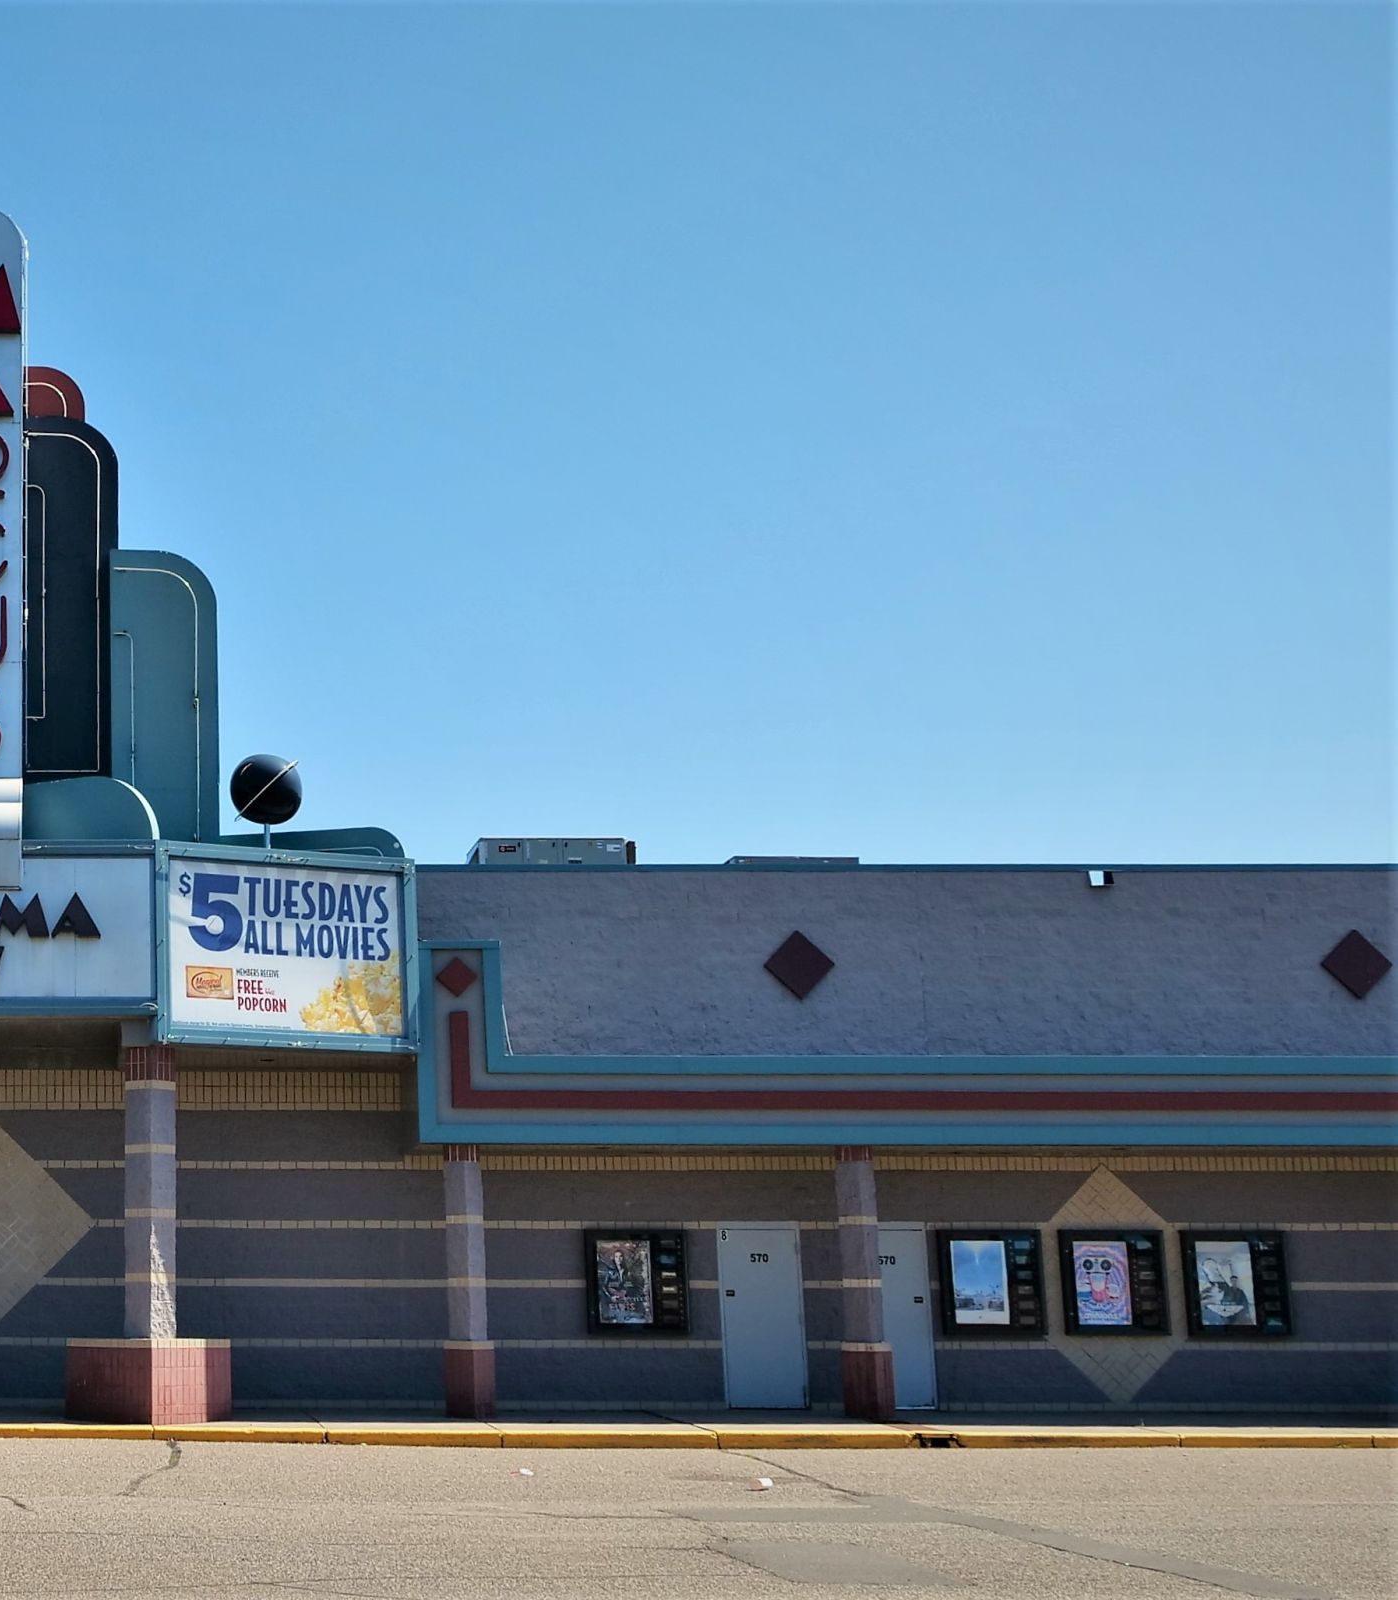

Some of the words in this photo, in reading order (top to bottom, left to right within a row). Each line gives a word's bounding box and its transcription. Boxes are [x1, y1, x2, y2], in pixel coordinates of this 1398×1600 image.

[244, 876, 389, 925] TUESDAYS
[244, 919, 288, 956] ALL
[296, 923, 391, 962] MOVIES
[237, 979, 263, 995] FREE
[237, 996, 287, 1013] POPCORN
[750, 1253, 769, 1263] 570
